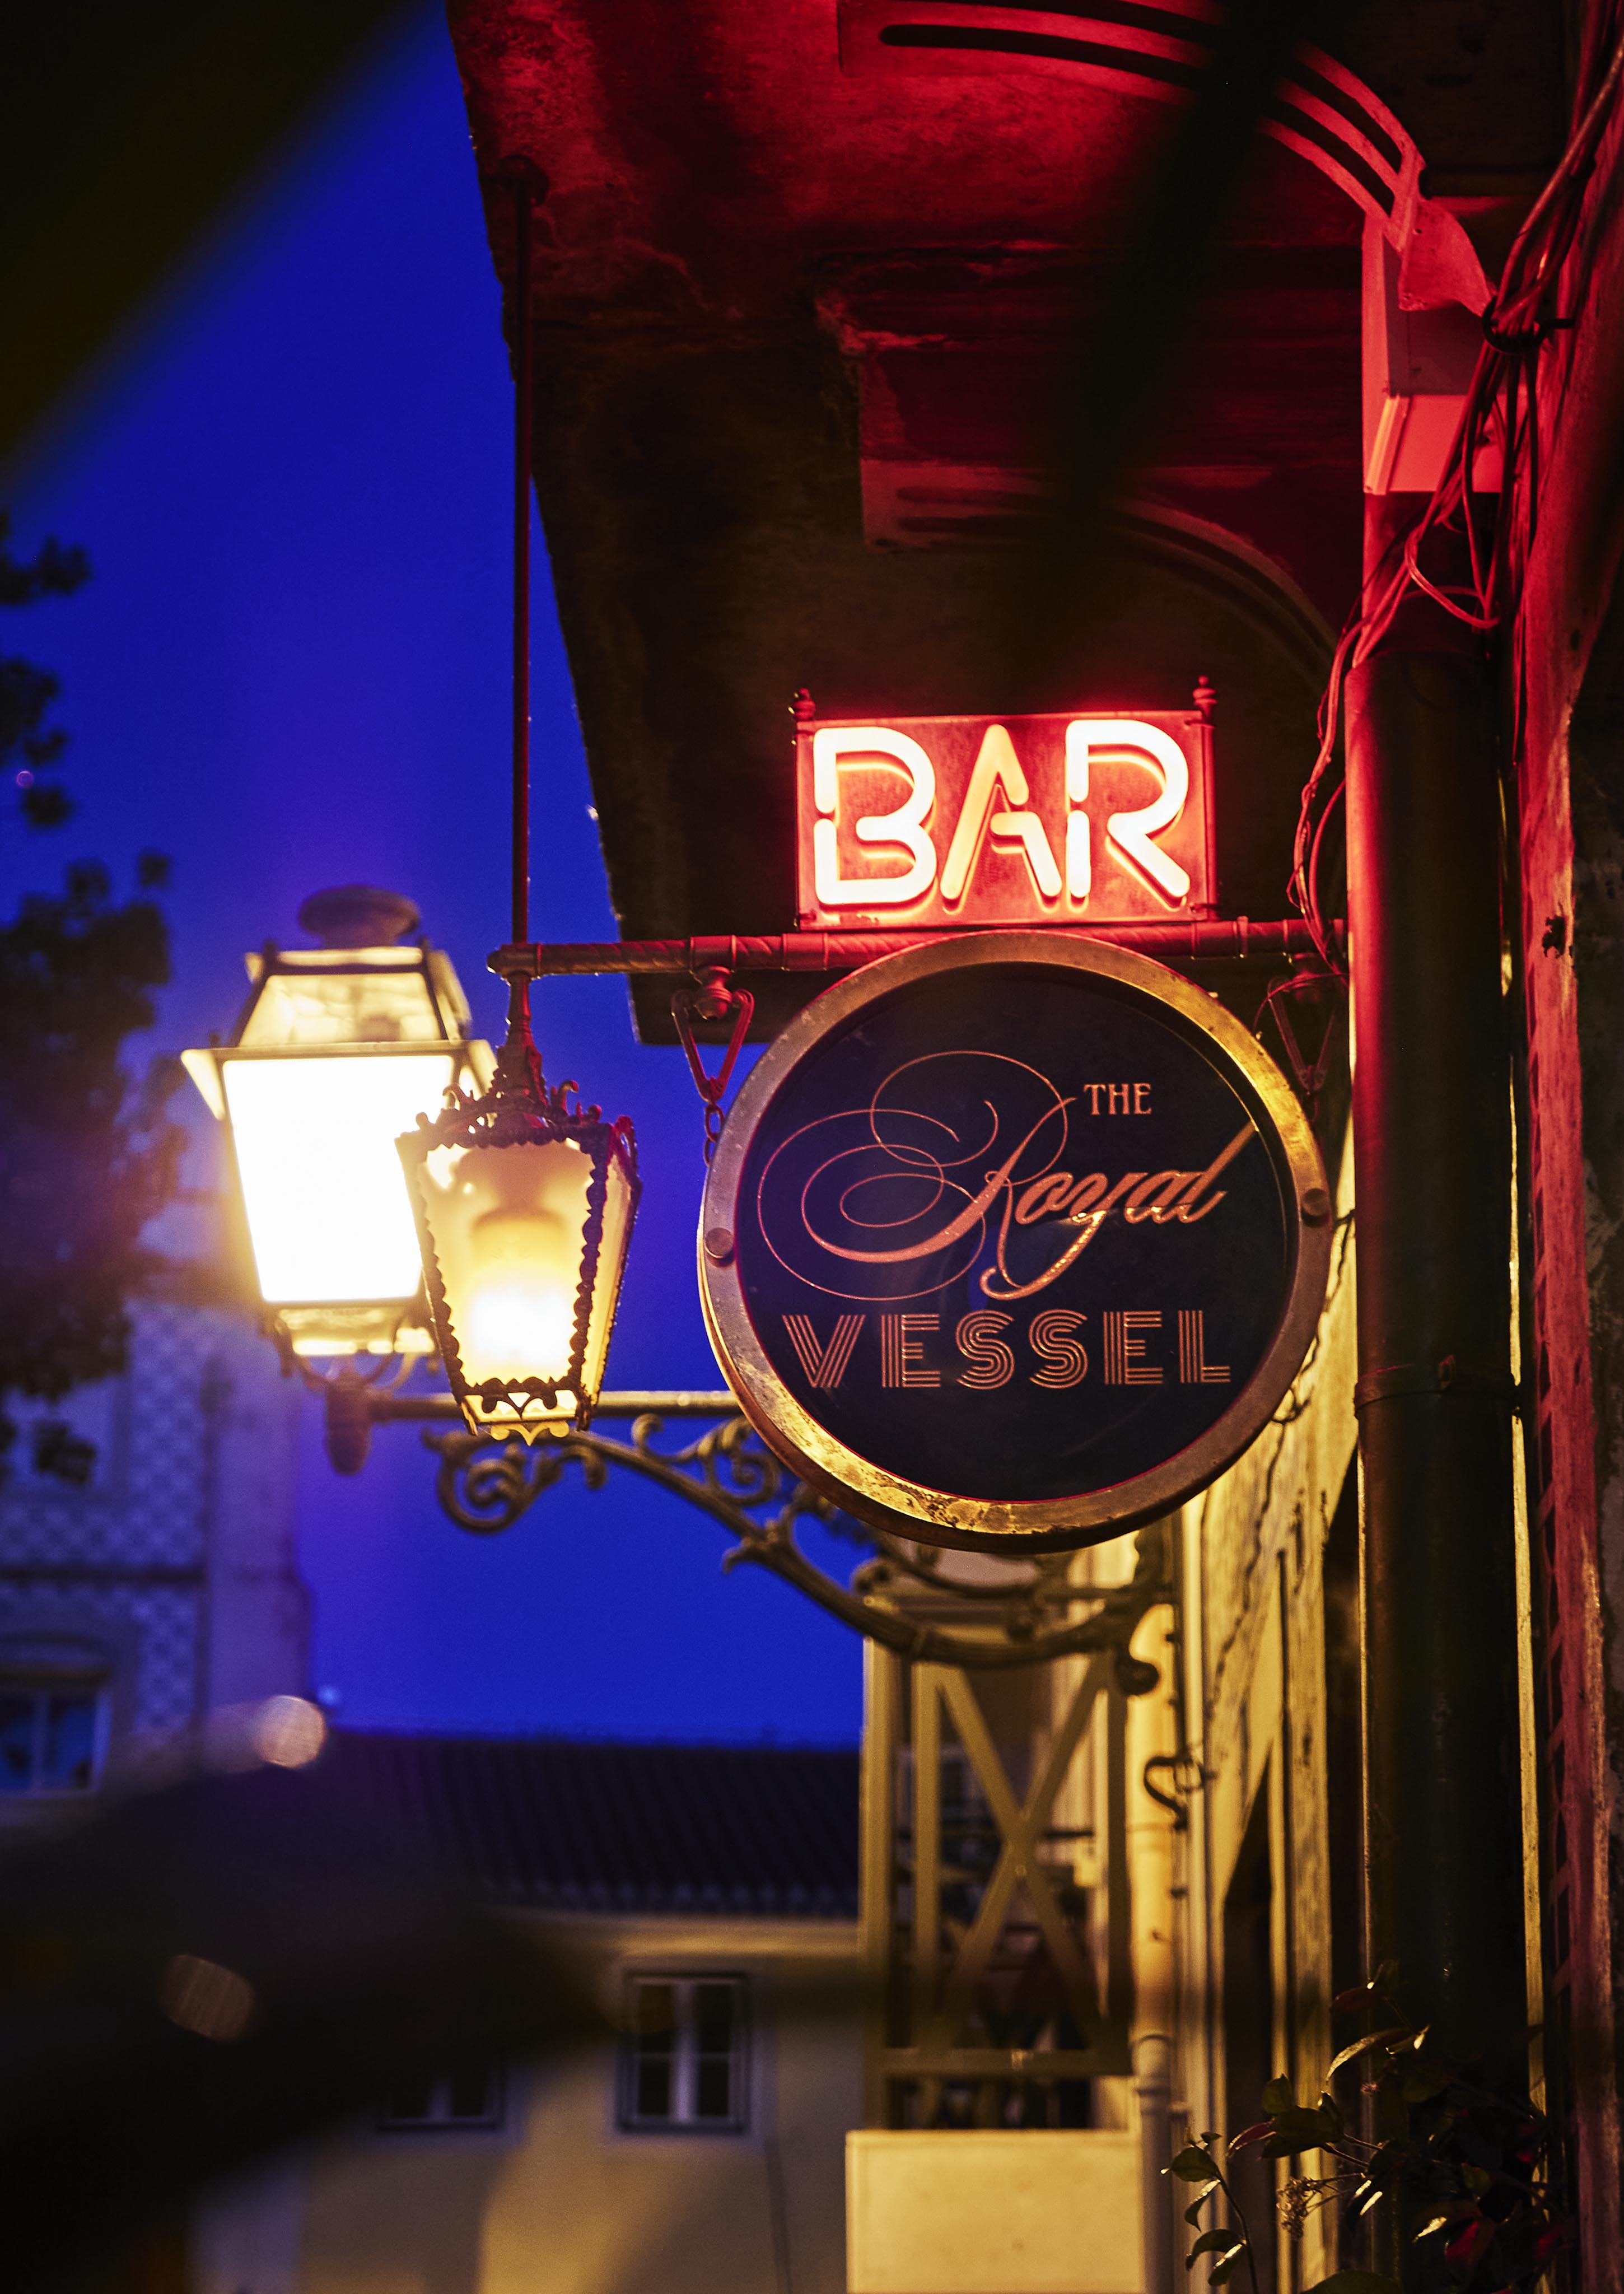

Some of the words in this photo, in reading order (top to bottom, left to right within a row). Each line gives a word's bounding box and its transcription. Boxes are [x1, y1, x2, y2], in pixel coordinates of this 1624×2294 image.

[813, 719, 1191, 904] BAR
[1083, 1083, 1152, 1116] THE
[757, 1050, 1259, 1301] Royal
[782, 1309, 1231, 1390] VESSEL
